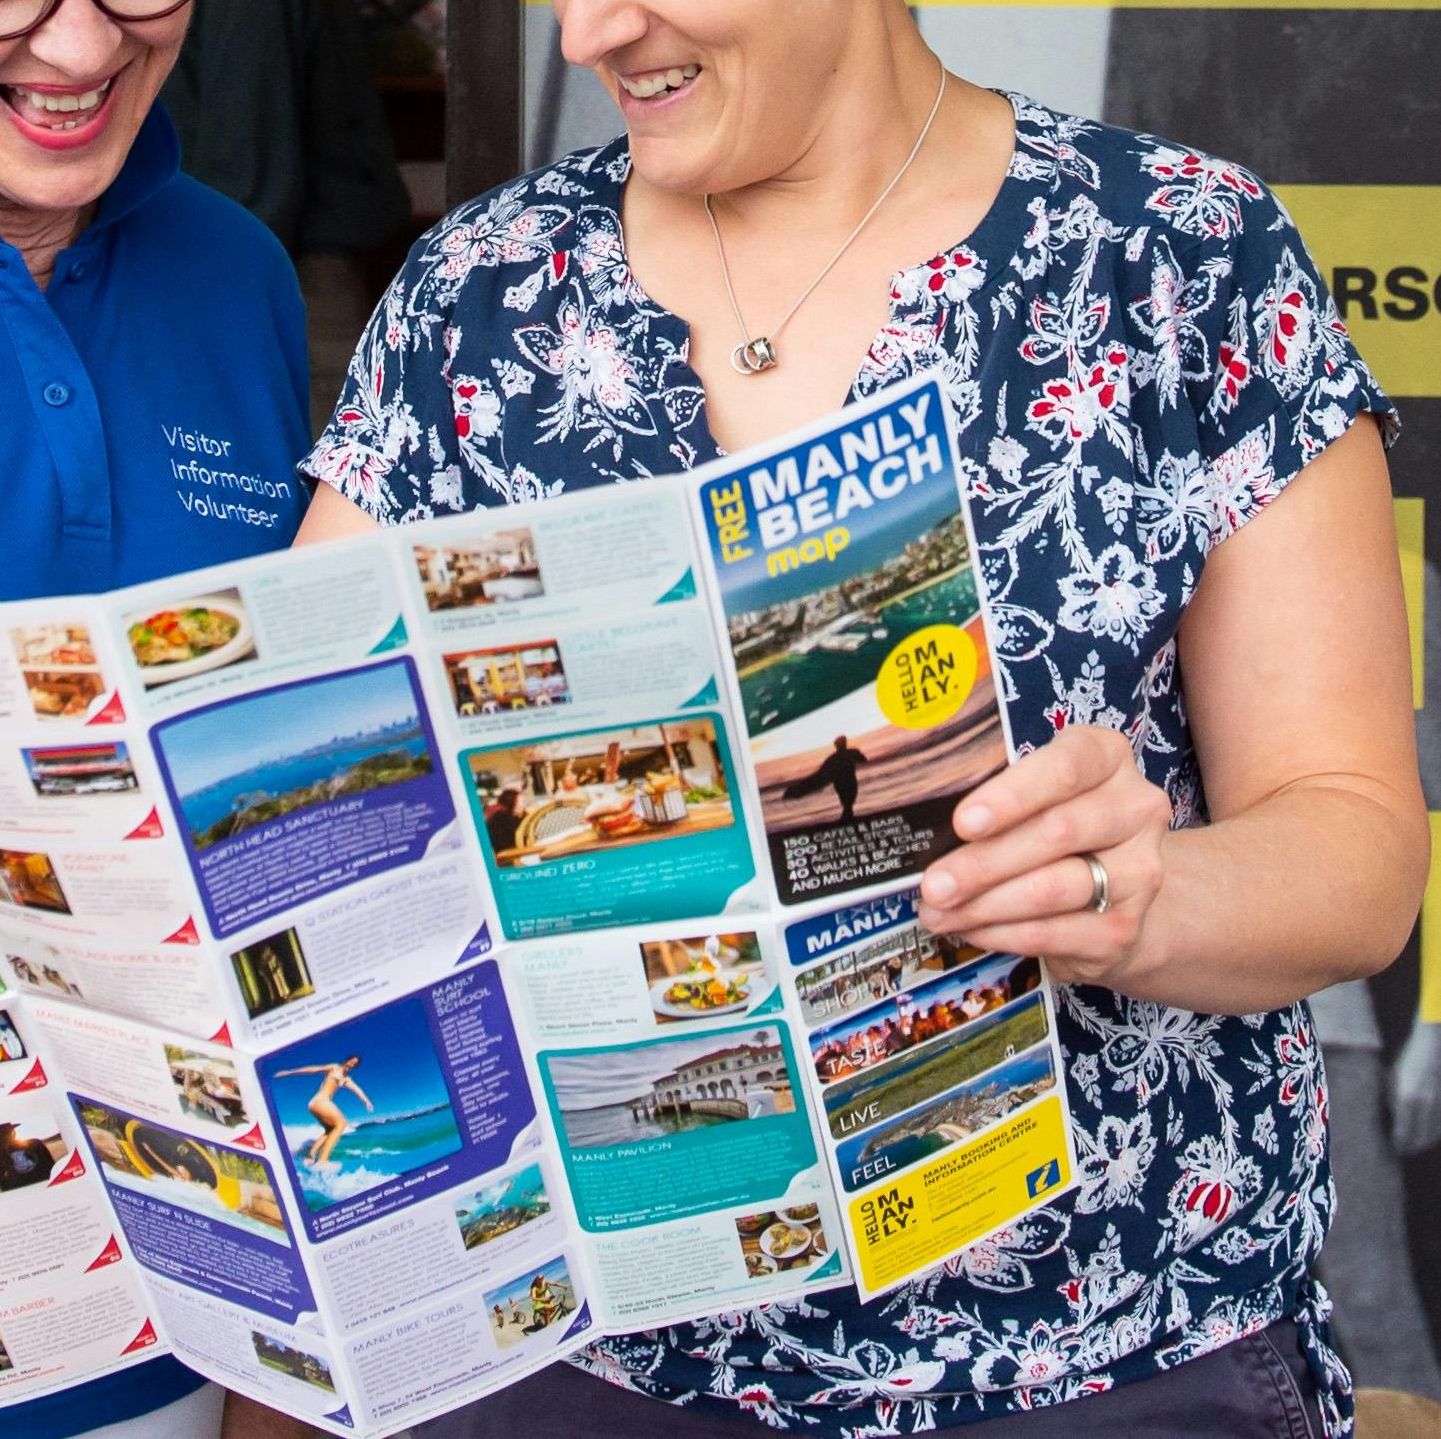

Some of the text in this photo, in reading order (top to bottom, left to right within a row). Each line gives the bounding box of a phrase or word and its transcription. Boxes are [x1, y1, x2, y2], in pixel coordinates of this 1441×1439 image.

[161, 423, 232, 457] Visitor
[748, 393, 932, 511] MANLY
[171, 457, 291, 500] Information
[757, 434, 943, 550] BEACH
[178, 490, 280, 529] Volunteer
[710, 480, 753, 563] FREE
[766, 526, 851, 578] map
[896, 654, 918, 714] HELLO
[199, 799, 364, 868] NORTH HEAD SANCTUARY
[821, 837, 857, 849] RETAIL
[864, 825, 911, 841] STORES
[858, 823, 868, 832] &
[871, 815, 904, 831] BARS
[811, 842, 875, 863] ACTIVITIES
[880, 839, 888, 848] &
[893, 829, 934, 844] TOURS
[812, 857, 856, 875] WALKS
[860, 854, 869, 863] &
[873, 841, 930, 860] BEACHES
[410, 865, 458, 888] TOURS
[562, 860, 596, 874] ZERO
[792, 858, 902, 894] AND MUCH MORE
[806, 906, 902, 954] MANLY
[432, 973, 475, 999] MANLY
[434, 988, 463, 1008] SURF
[437, 987, 492, 1017] SCHOOL
[826, 1041, 887, 1076] TASTE
[839, 1100, 883, 1133] LIVE
[572, 1142, 672, 1162] MANLY PAVILION
[923, 1117, 1032, 1180] MANLY BOOKING AND
[924, 1145, 997, 1188] INFORMATION
[999, 1122, 1038, 1148] CENTRE
[850, 1155, 897, 1186] FEEL
[111, 1188, 145, 1208] MANLY
[147, 1201, 171, 1216] SURF
[184, 1213, 213, 1232] SLIDE
[319, 1208, 340, 1223] North
[367, 1192, 383, 1205] Surf
[404, 1175, 425, 1188] Manly
[427, 1164, 449, 1178] Beach
[877, 1188, 899, 1209] M
[881, 1196, 915, 1224] AN
[322, 1219, 416, 1262] ECOTREASURES
[596, 1226, 702, 1251] THE COOK ROOM
[861, 1201, 880, 1246] HELLO
[11, 1297, 55, 1316] BARBER
[353, 1303, 464, 1354] MANLY BIKE TOURS
